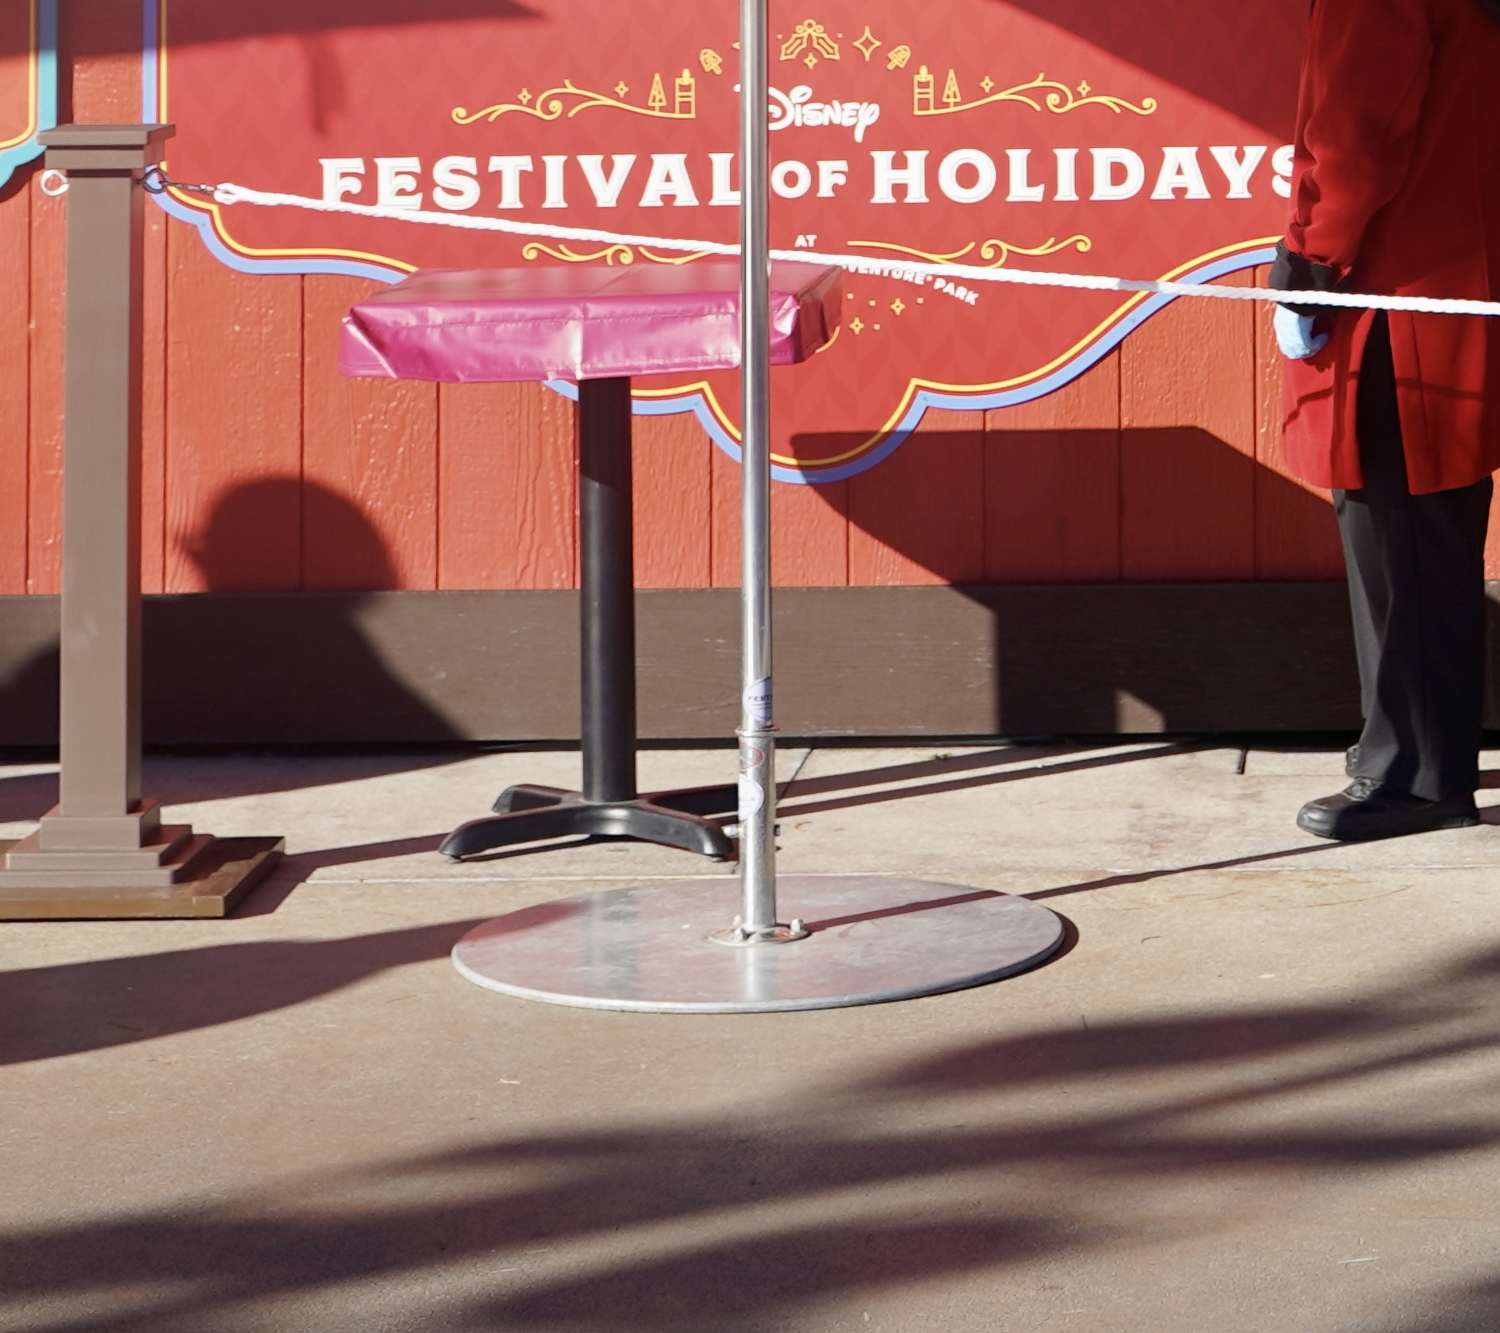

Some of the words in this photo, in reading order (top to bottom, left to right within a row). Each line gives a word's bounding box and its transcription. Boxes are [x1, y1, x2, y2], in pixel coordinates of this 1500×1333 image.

[318, 152, 741, 211] FESTIVAL
[771, 160, 849, 198] OF
[794, 234, 817, 249] AT
[933, 277, 980, 306] PARK
